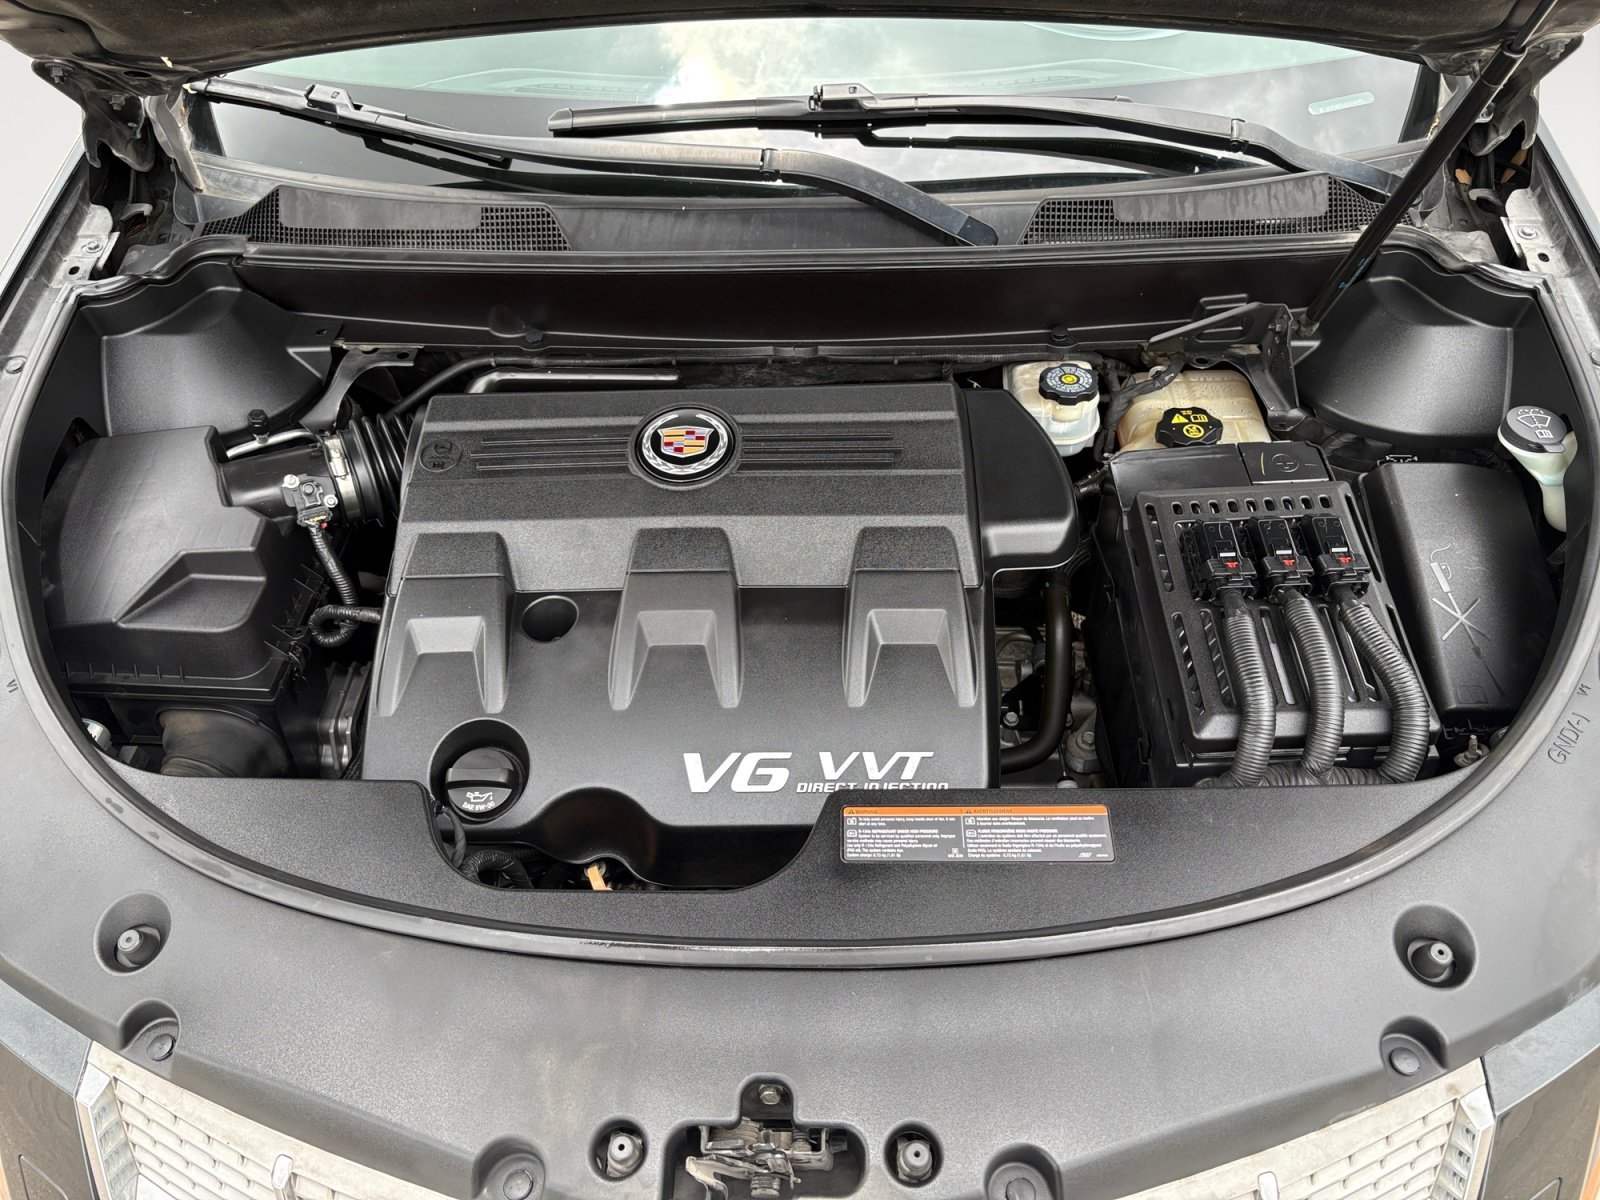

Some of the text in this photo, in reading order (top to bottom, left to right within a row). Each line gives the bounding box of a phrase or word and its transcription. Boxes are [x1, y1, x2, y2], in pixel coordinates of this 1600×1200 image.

[683, 752, 934, 792] V6 VVT
[796, 782, 858, 792] DIRECT
